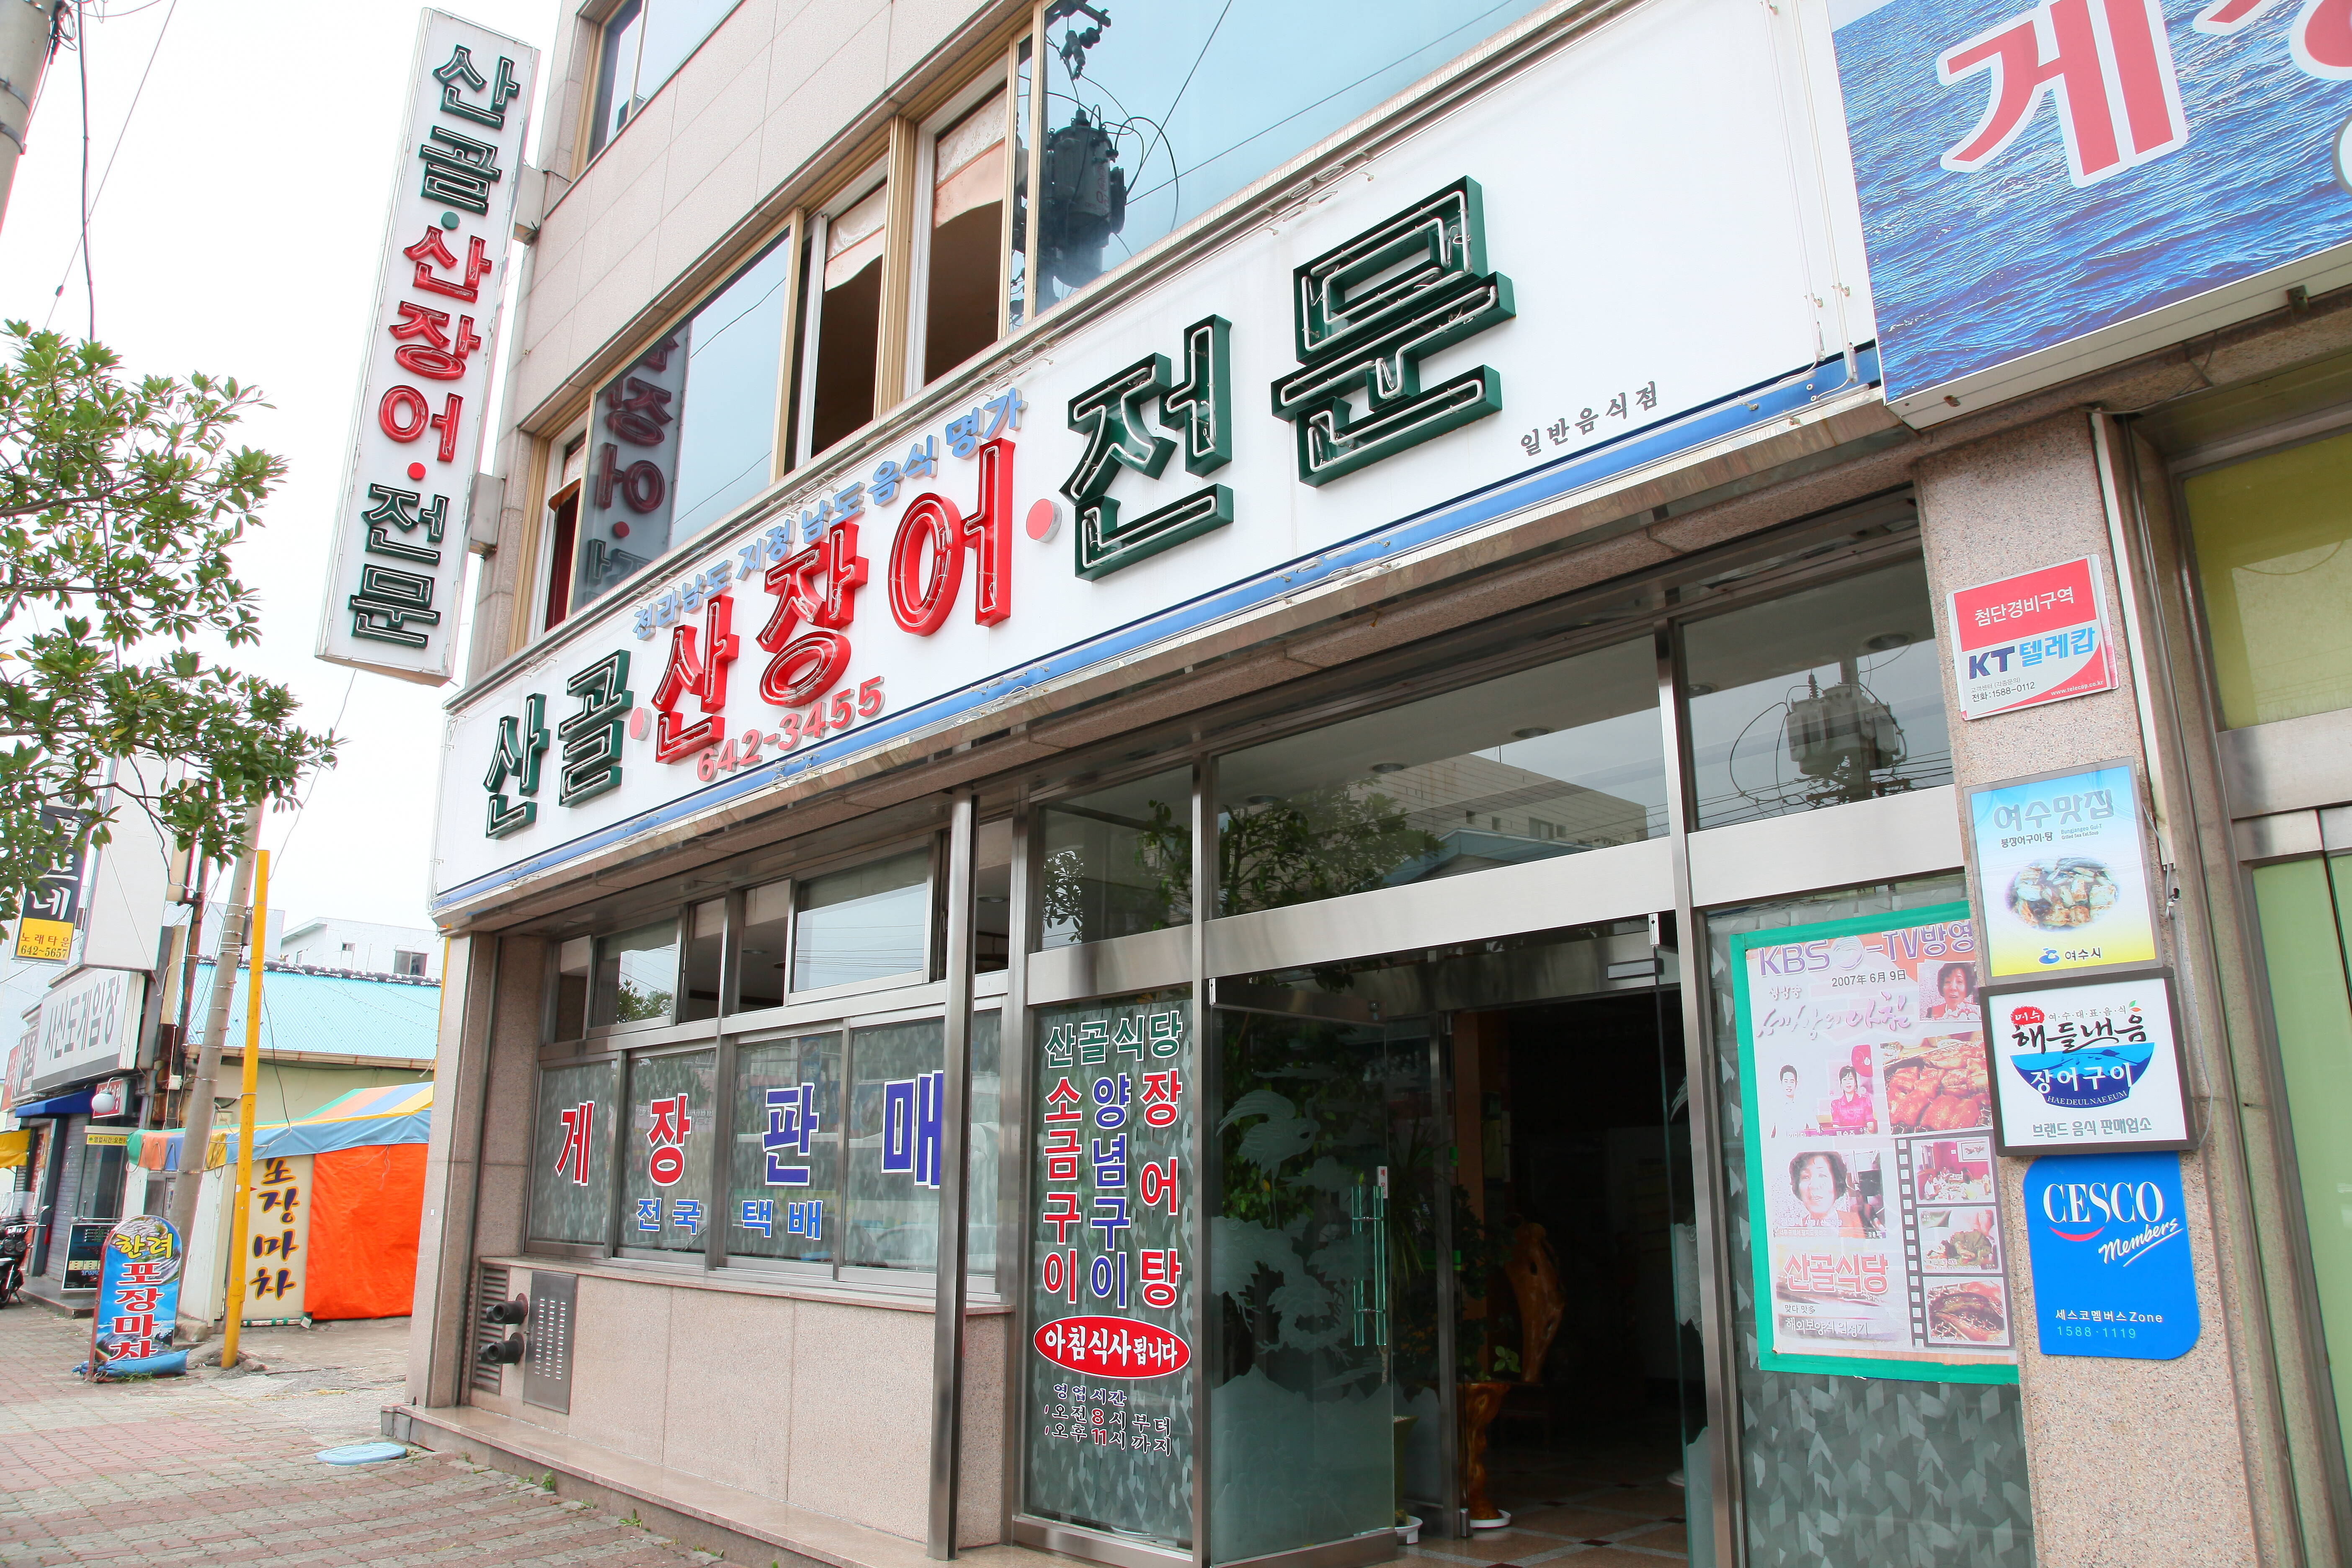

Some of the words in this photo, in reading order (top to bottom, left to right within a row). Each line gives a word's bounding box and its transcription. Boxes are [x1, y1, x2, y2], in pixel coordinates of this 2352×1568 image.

[1521, 381, 1657, 456] 일반음식점
[633, 559, 732, 640] 전라남도
[736, 519, 796, 581] 지정
[945, 387, 1028, 460] 명가
[1975, 586, 2074, 627] 첨단경비구역
[1969, 646, 2015, 680] KT
[2019, 627, 2095, 667] 텔레캅
[2050, 680, 2103, 696] www.telecop.co.kr
[696, 676, 886, 782] 642-3455
[1993, 789, 2115, 832] 여수맛집
[21, 933, 70, 948] 노래타운
[1759, 939, 1831, 977] KBS
[2065, 947, 2102, 961] 여수시
[1832, 976, 1867, 987] 2007年
[1870, 971, 1885, 983] 6月
[1890, 970, 1906, 980] 9日
[2015, 1011, 2041, 1021] 여수
[1044, 1010, 1183, 1068] 산골식당
[2030, 1062, 2133, 1094] 장어구이
[2032, 1123, 2068, 1138] 브랜드
[2072, 1120, 2097, 1137] 음식
[2100, 1117, 2152, 1136] 판매업소
[636, 1197, 701, 1235] 전국
[740, 1199, 824, 1240] 택배
[2043, 1181, 2164, 1223] CESCO
[115, 1233, 173, 1259] 한려
[2098, 1217, 2178, 1264] Members
[1783, 1253, 1889, 1294] 산골식당
[108, 1262, 164, 1361] 포장마차
[1051, 1403, 1087, 1424] 오전
[1051, 1422, 1088, 1442] 오후
